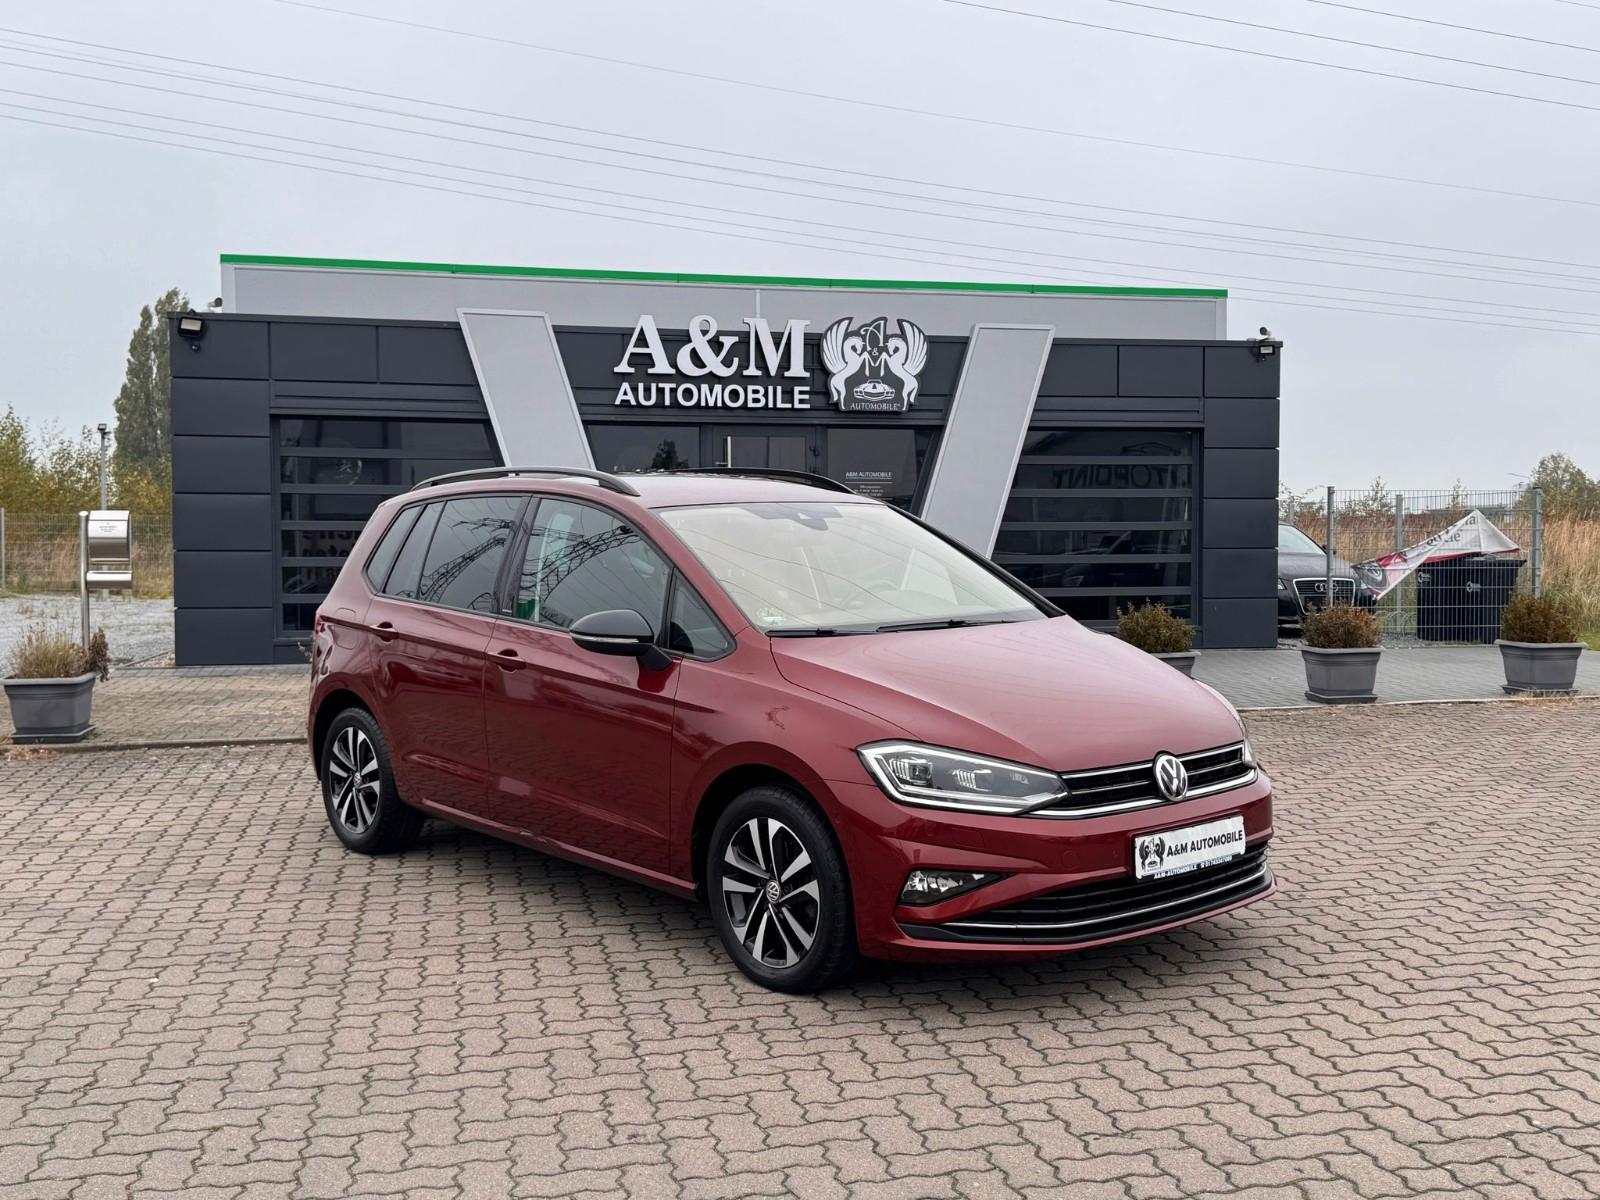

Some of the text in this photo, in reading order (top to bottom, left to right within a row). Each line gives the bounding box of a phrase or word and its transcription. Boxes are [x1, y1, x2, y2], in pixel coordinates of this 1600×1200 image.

[613, 314, 811, 378] A&M
[614, 382, 811, 409] AUTOMOBILE
[850, 402, 899, 411] AUTOMOBILE
[1166, 830, 1243, 857] A&M AUTOMOBILE
